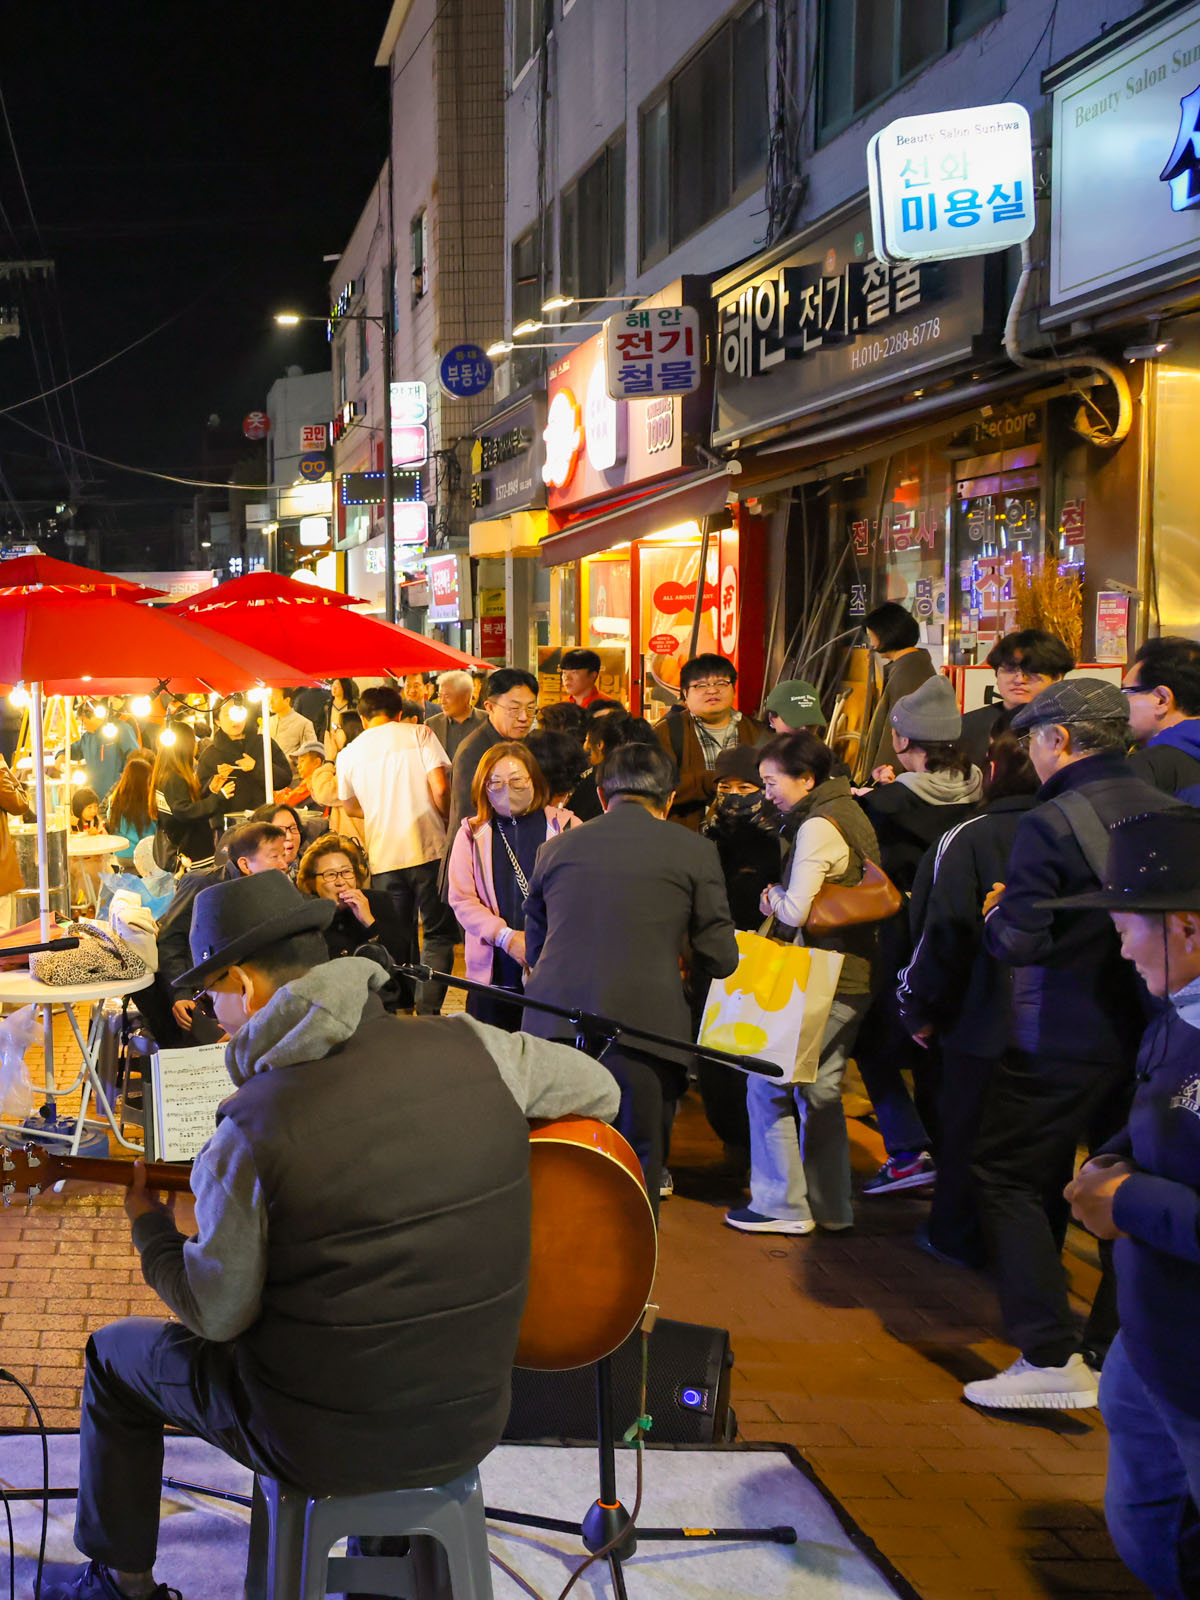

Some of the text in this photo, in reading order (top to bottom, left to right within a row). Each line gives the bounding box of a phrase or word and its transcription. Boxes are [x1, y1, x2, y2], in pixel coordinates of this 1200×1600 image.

[1075, 88, 1122, 129] Beauty
[1126, 64, 1167, 100] Salon
[896, 120, 1020, 146] Beauty Salon Sunhwa
[901, 180, 1026, 232] 미용실
[625, 308, 683, 329] 해안
[724, 267, 789, 377] 해안
[616, 327, 694, 361] 전기
[851, 316, 941, 371] H.010-2288-8778
[447, 363, 487, 388] 부동산
[616, 361, 696, 394] 철물
[303, 426, 325, 442] 코인
